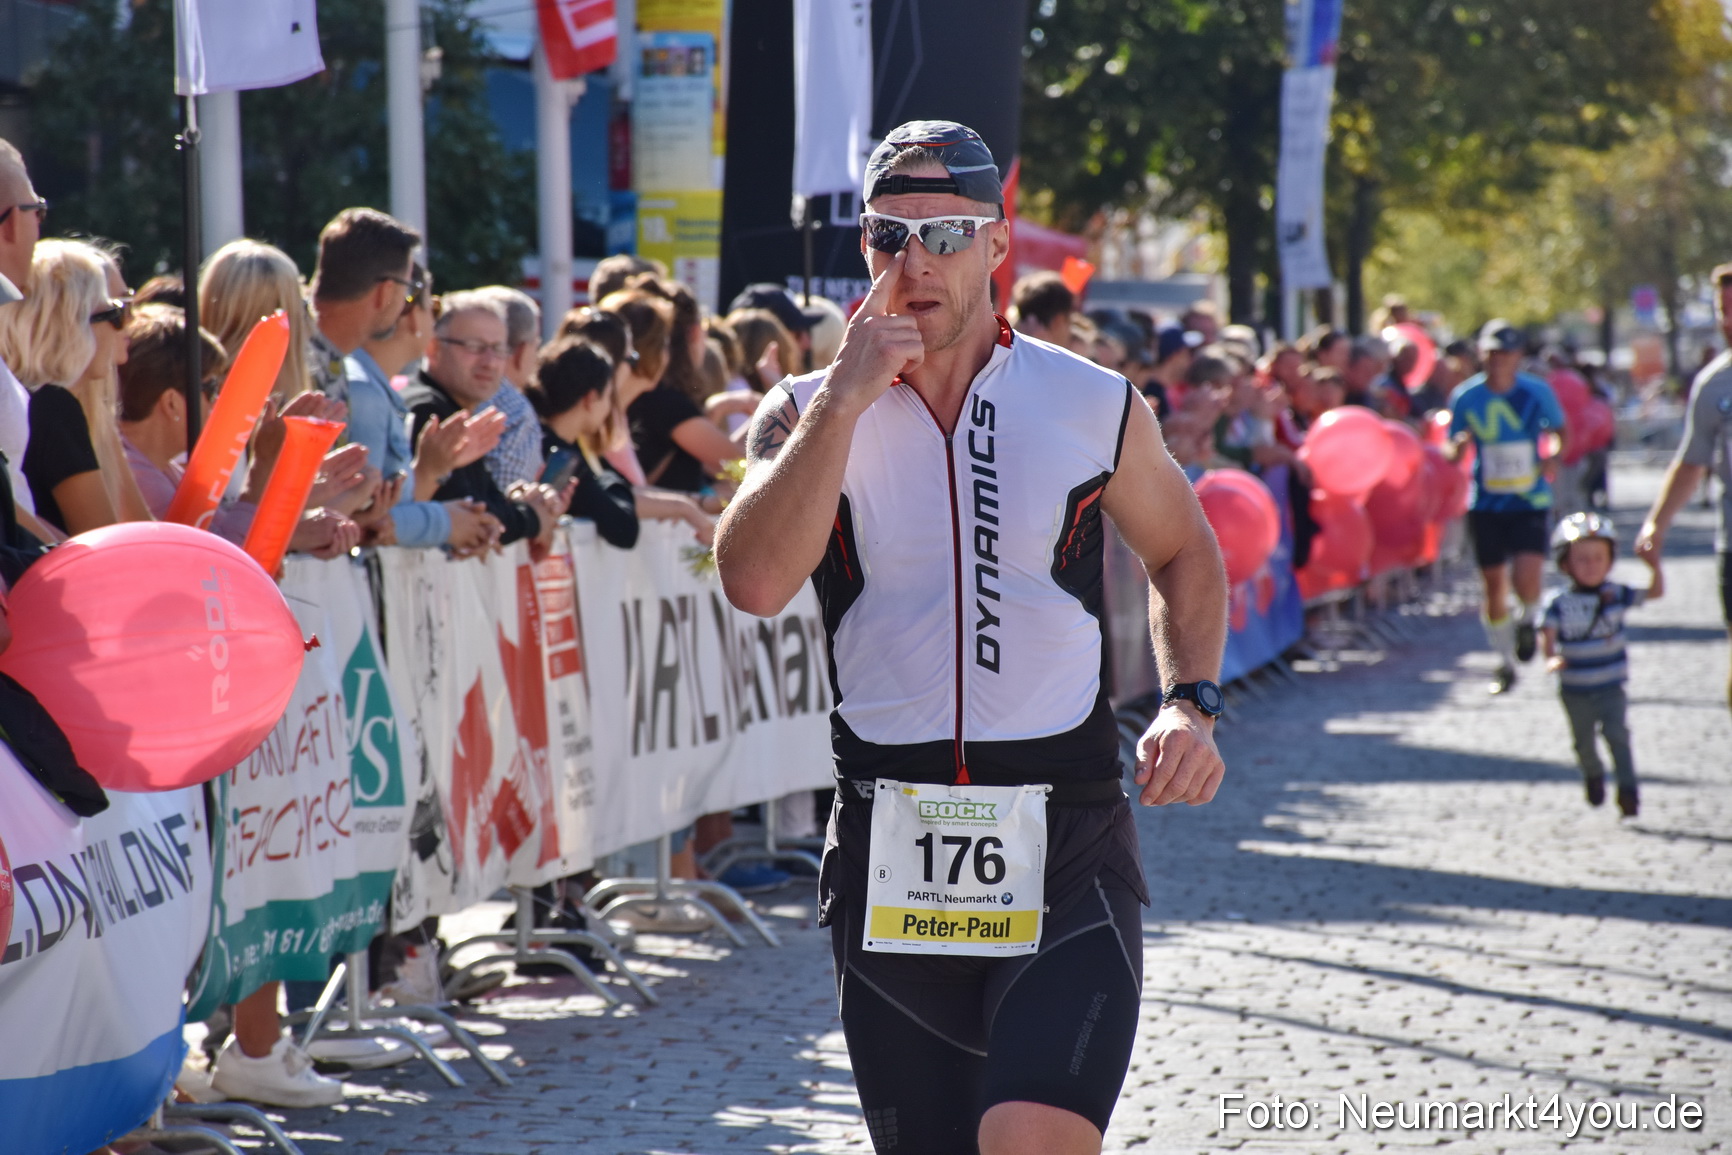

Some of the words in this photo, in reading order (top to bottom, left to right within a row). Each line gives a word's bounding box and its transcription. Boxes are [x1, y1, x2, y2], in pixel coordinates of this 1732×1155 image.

[968, 392, 1001, 675] DYNAMICS
[919, 800, 998, 821] BOCK
[943, 820, 951, 828] by
[915, 832, 1006, 885] 176
[879, 869, 886, 879] B
[907, 891, 943, 903] PARTL
[944, 894, 997, 904] Neumarkt
[902, 913, 1011, 938] Peter-Paul
[1069, 1019, 1096, 1076] compression
[1086, 991, 1108, 1021] sports
